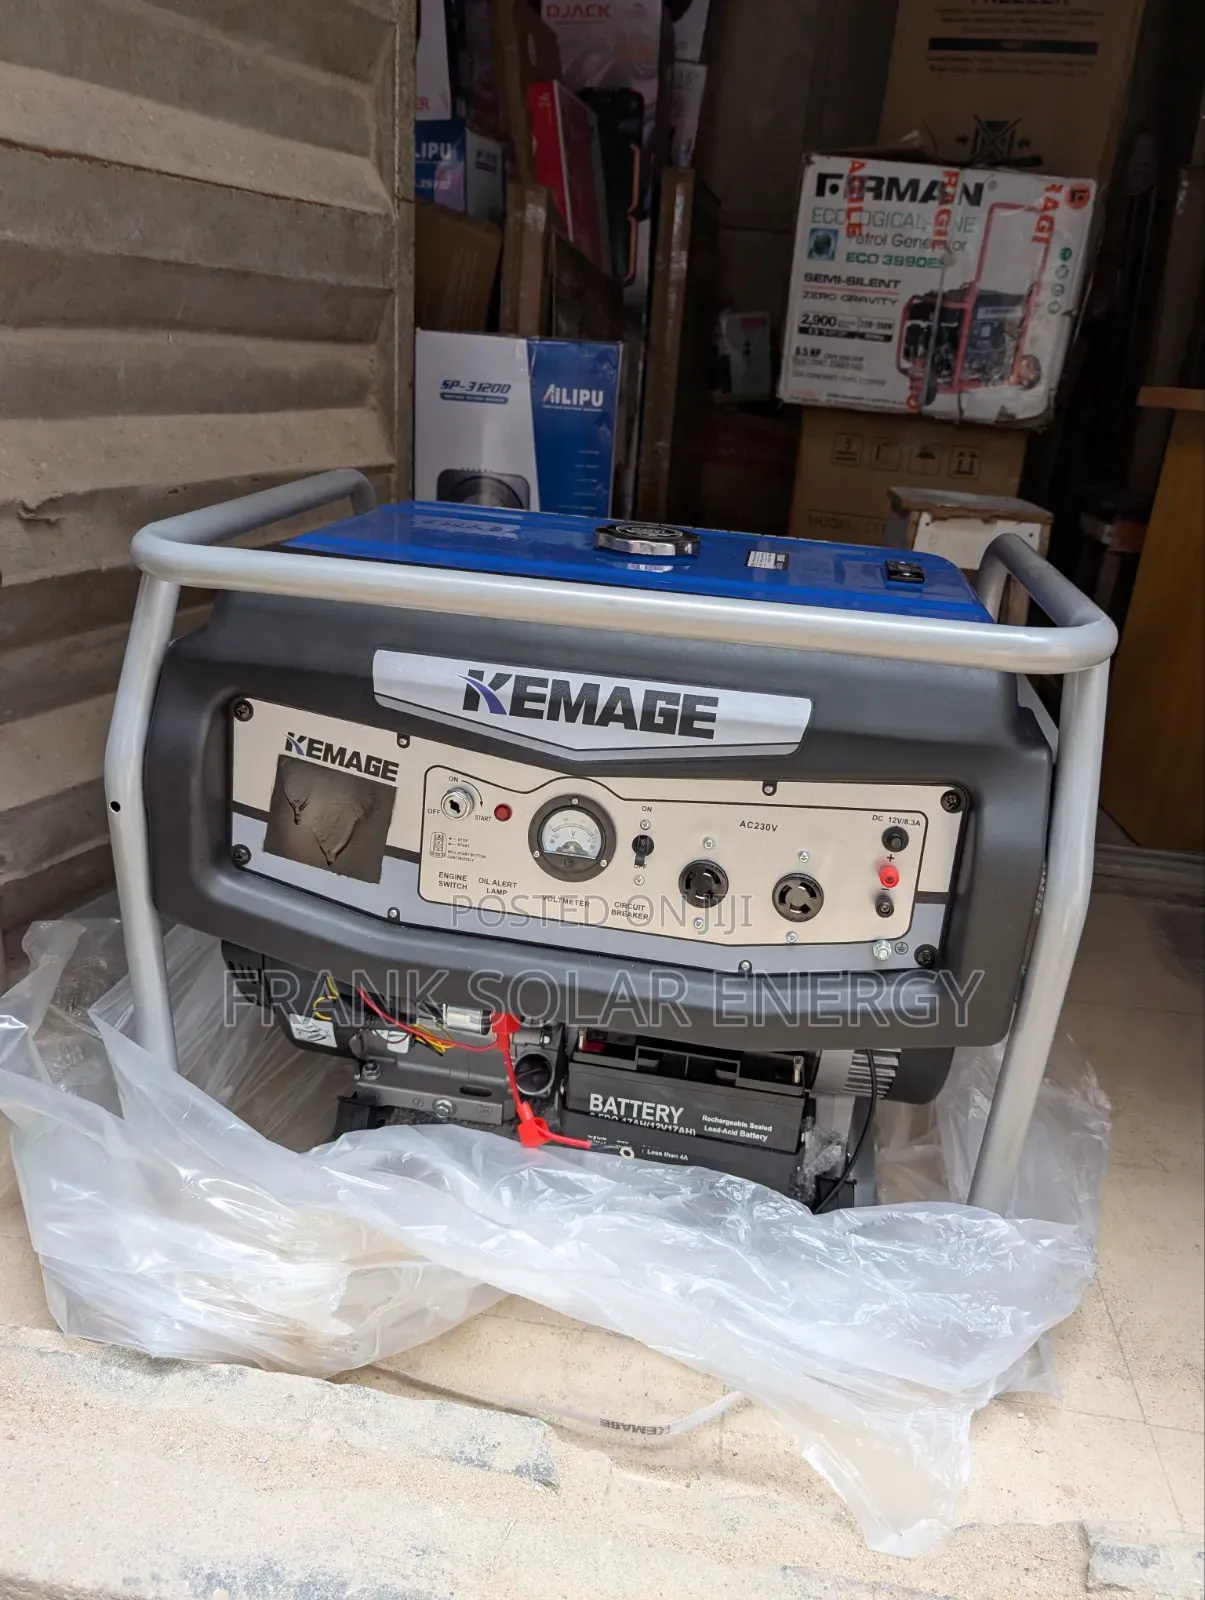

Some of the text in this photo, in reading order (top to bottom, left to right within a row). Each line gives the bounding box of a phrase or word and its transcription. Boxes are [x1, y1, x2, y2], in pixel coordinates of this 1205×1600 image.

[803, 272, 902, 289] SEMI-SILENT
[457, 668, 719, 740] KEMAGE
[282, 731, 400, 783] KEMAGE
[448, 775, 459, 783] ON
[641, 805, 653, 813] ON
[474, 814, 492, 823] START
[871, 813, 922, 828] DC 12V/8.3A
[738, 820, 779, 833] AC230V
[438, 871, 468, 882] ENGINE
[438, 880, 468, 890] SWITCH
[477, 877, 518, 889] OIL ALERT
[486, 887, 508, 897] LAMP
[541, 894, 590, 908] VOLTMETER
[614, 901, 646, 911] CIRCUIT
[611, 908, 649, 920] BREAKER
[589, 1092, 685, 1125] BATTERY
[702, 1114, 773, 1132] Rechargeable Sealed
[703, 1125, 768, 1143] Lead-Acid Battery
[646, 1148, 662, 1157] Less
[663, 1150, 678, 1160] than
